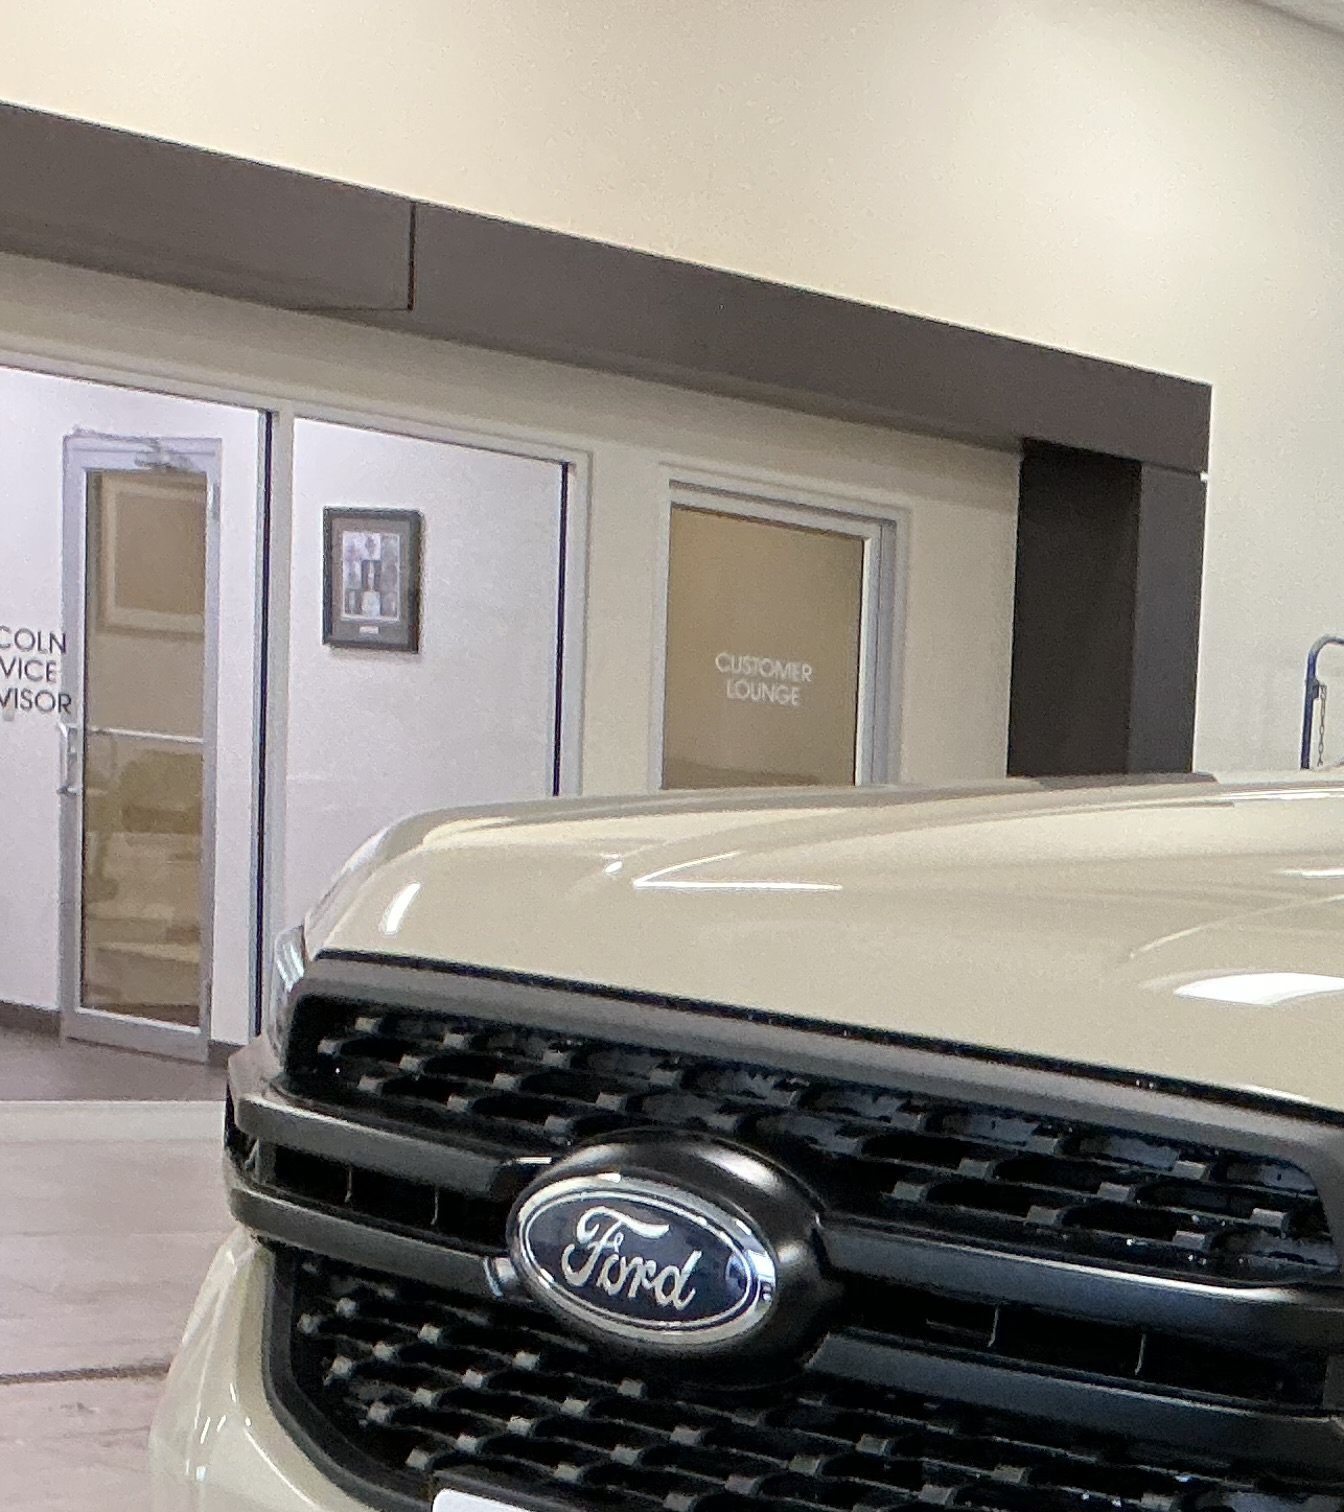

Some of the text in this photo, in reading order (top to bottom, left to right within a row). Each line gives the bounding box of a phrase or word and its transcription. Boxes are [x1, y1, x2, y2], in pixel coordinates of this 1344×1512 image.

[715, 652, 813, 682] CUSTOMER
[726, 679, 799, 706] LOUNGE
[560, 1205, 702, 1311] Ford
